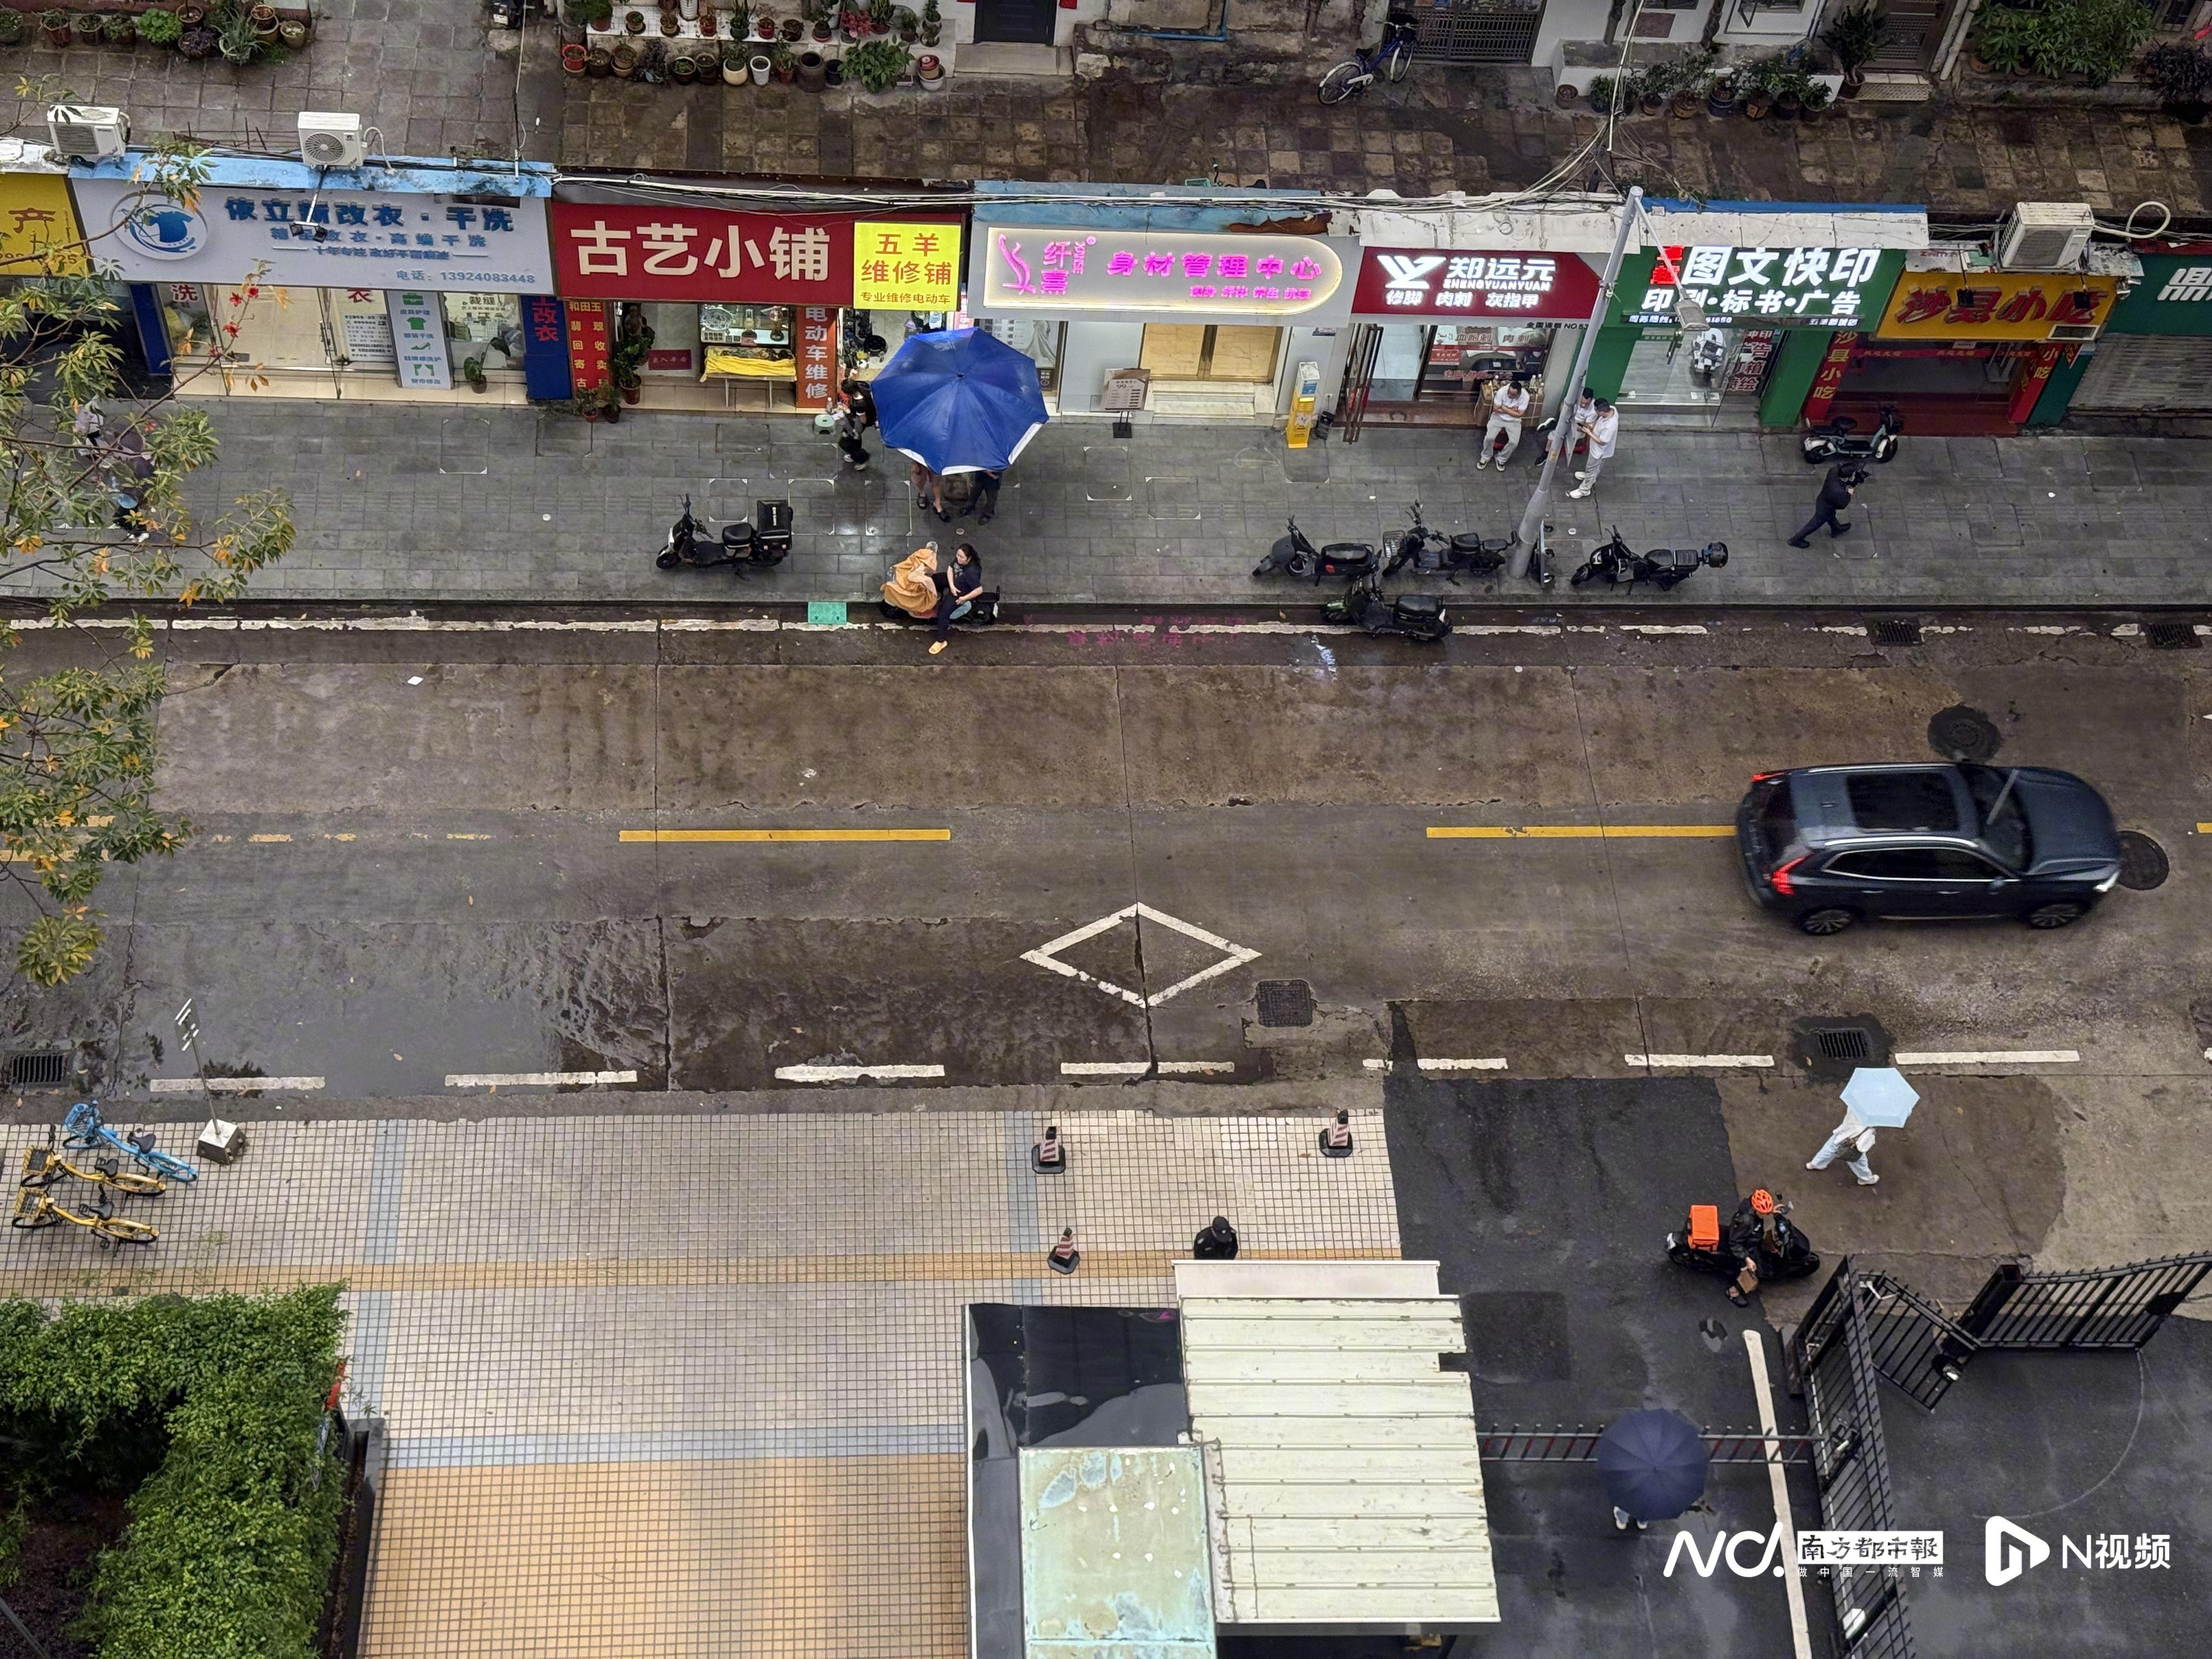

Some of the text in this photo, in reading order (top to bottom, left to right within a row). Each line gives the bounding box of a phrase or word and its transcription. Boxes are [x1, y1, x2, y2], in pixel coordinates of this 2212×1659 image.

[570, 221, 830, 281] 古艺小铺
[875, 233, 940, 257] 五羊
[861, 259, 952, 285] 维修铺
[1107, 251, 1322, 280] 身材管理中心
[1446, 257, 1557, 280] 郑远元
[1680, 246, 1882, 287] 图文快印
[171, 284, 199, 302] 洗
[1442, 278, 1551, 292] ZHENGYUANYUAN
[569, 302, 602, 312] 和田玉
[860, 291, 951, 304] 专业维修电动车
[1385, 290, 1539, 309] 修脚 肉刺 灰指甲
[1895, 286, 2109, 324] 沙县小吃
[572, 340, 606, 351] 回收
[805, 307, 828, 399] 电动车维修
[574, 359, 608, 370] 寄卖
[1813, 330, 1859, 399] 沙县小吃
